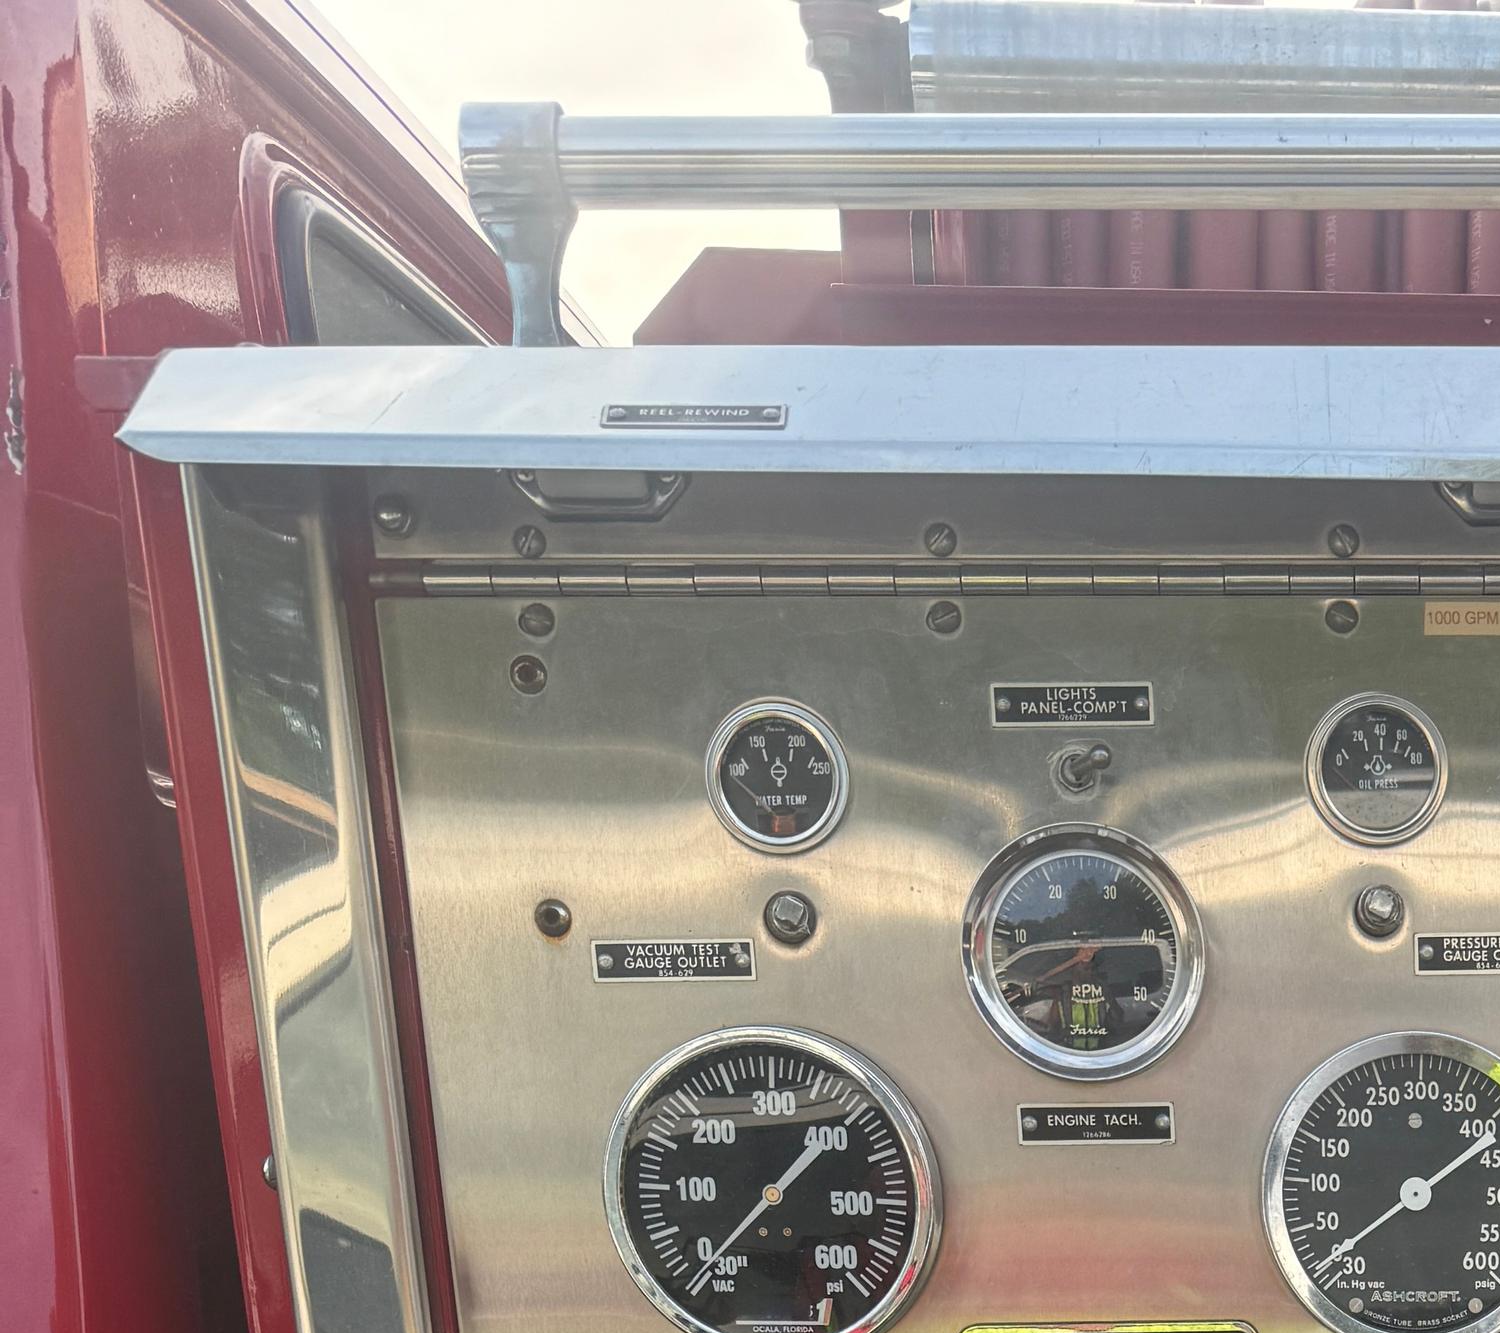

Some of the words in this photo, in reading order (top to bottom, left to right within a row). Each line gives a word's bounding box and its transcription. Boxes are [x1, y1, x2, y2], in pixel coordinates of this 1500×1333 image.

[640, 408, 749, 416] REEL-REWIND
[1428, 612, 1460, 625] 1000
[1464, 612, 1499, 625] GPM
[1047, 688, 1096, 701] LIGHTS
[1353, 730, 1364, 741] 20
[1374, 724, 1386, 736] 40
[1397, 729, 1407, 741] 60
[750, 736, 765, 748] 150
[788, 736, 806, 747] 200
[1336, 754, 1342, 766] 0
[1410, 753, 1423, 764] 80
[729, 765, 745, 776] 100
[813, 762, 830, 775] 250
[1359, 779, 1372, 790] OIL
[1375, 779, 1398, 789] PRESS
[787, 796, 807, 805] TEMP
[1049, 885, 1062, 899] 20
[1104, 885, 1116, 900] 30
[1015, 929, 1026, 943] 10
[1141, 929, 1155, 943] 40
[627, 945, 685, 956] VACUUM
[692, 944, 719, 955] TEST
[1443, 950, 1488, 962] GAUGE
[624, 957, 672, 968] GAUGE
[678, 956, 727, 967] OUTLET
[1072, 985, 1102, 997] RPM
[1134, 986, 1147, 1001] 50
[752, 1091, 796, 1115] 300
[1048, 1115, 1096, 1127] ENGINE
[1105, 1114, 1142, 1126] TACH.
[693, 1120, 735, 1144] 200
[804, 1126, 847, 1151] 400
[676, 1177, 716, 1201] 100
[831, 1192, 873, 1216] 500
[815, 1245, 857, 1269] 600
[713, 1280, 735, 1292] VAC
[826, 1280, 843, 1294] psi
[1352, 1279, 1365, 1289] Hg
[1475, 1279, 1495, 1290] psig
[1393, 1319, 1412, 1327] TUBE
[1417, 1319, 1440, 1327] BRASS
[1442, 1311, 1468, 1324] SOCKET
